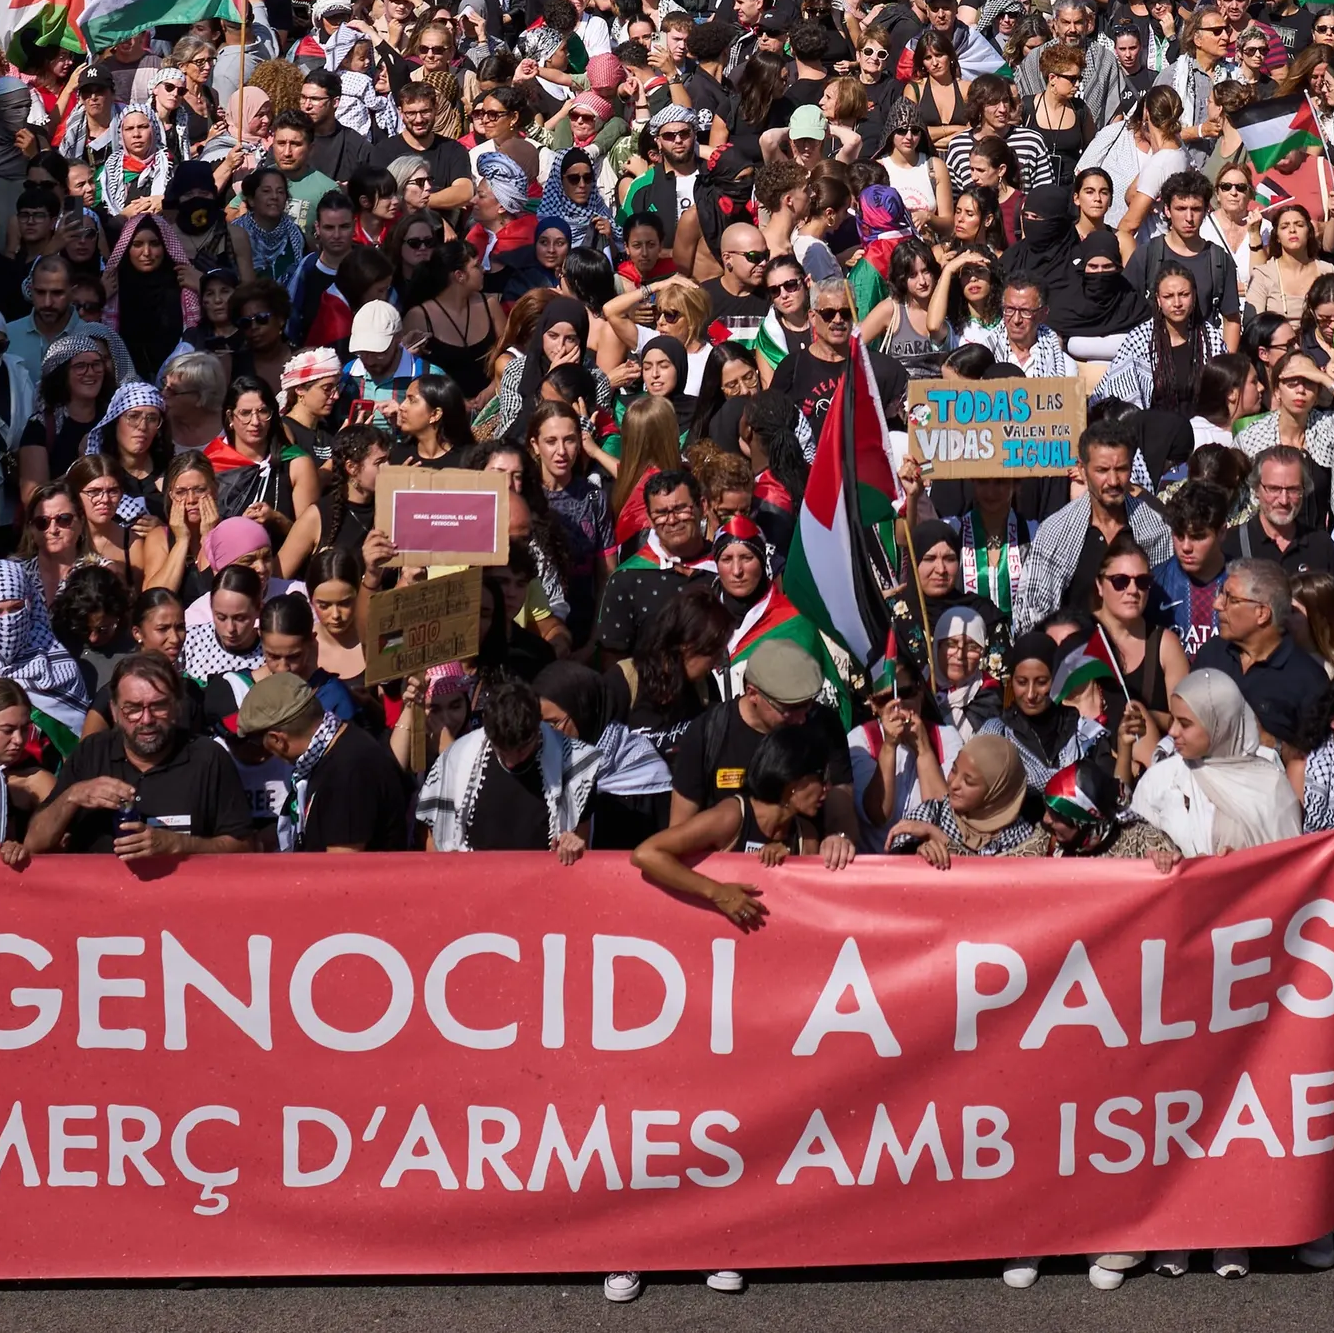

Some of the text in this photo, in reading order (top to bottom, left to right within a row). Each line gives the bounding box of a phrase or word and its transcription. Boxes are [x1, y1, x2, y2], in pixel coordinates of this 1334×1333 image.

[927, 388, 1064, 425] TODAS LAS
[915, 425, 1071, 462] VIDAS VALEN POR
[1002, 440, 1078, 470] IGUAL
[408, 620, 441, 648] NO
[792, 937, 902, 1057] A
[283, 1103, 744, 1192] D'ARMES
[776, 1101, 1014, 1186] AMB
